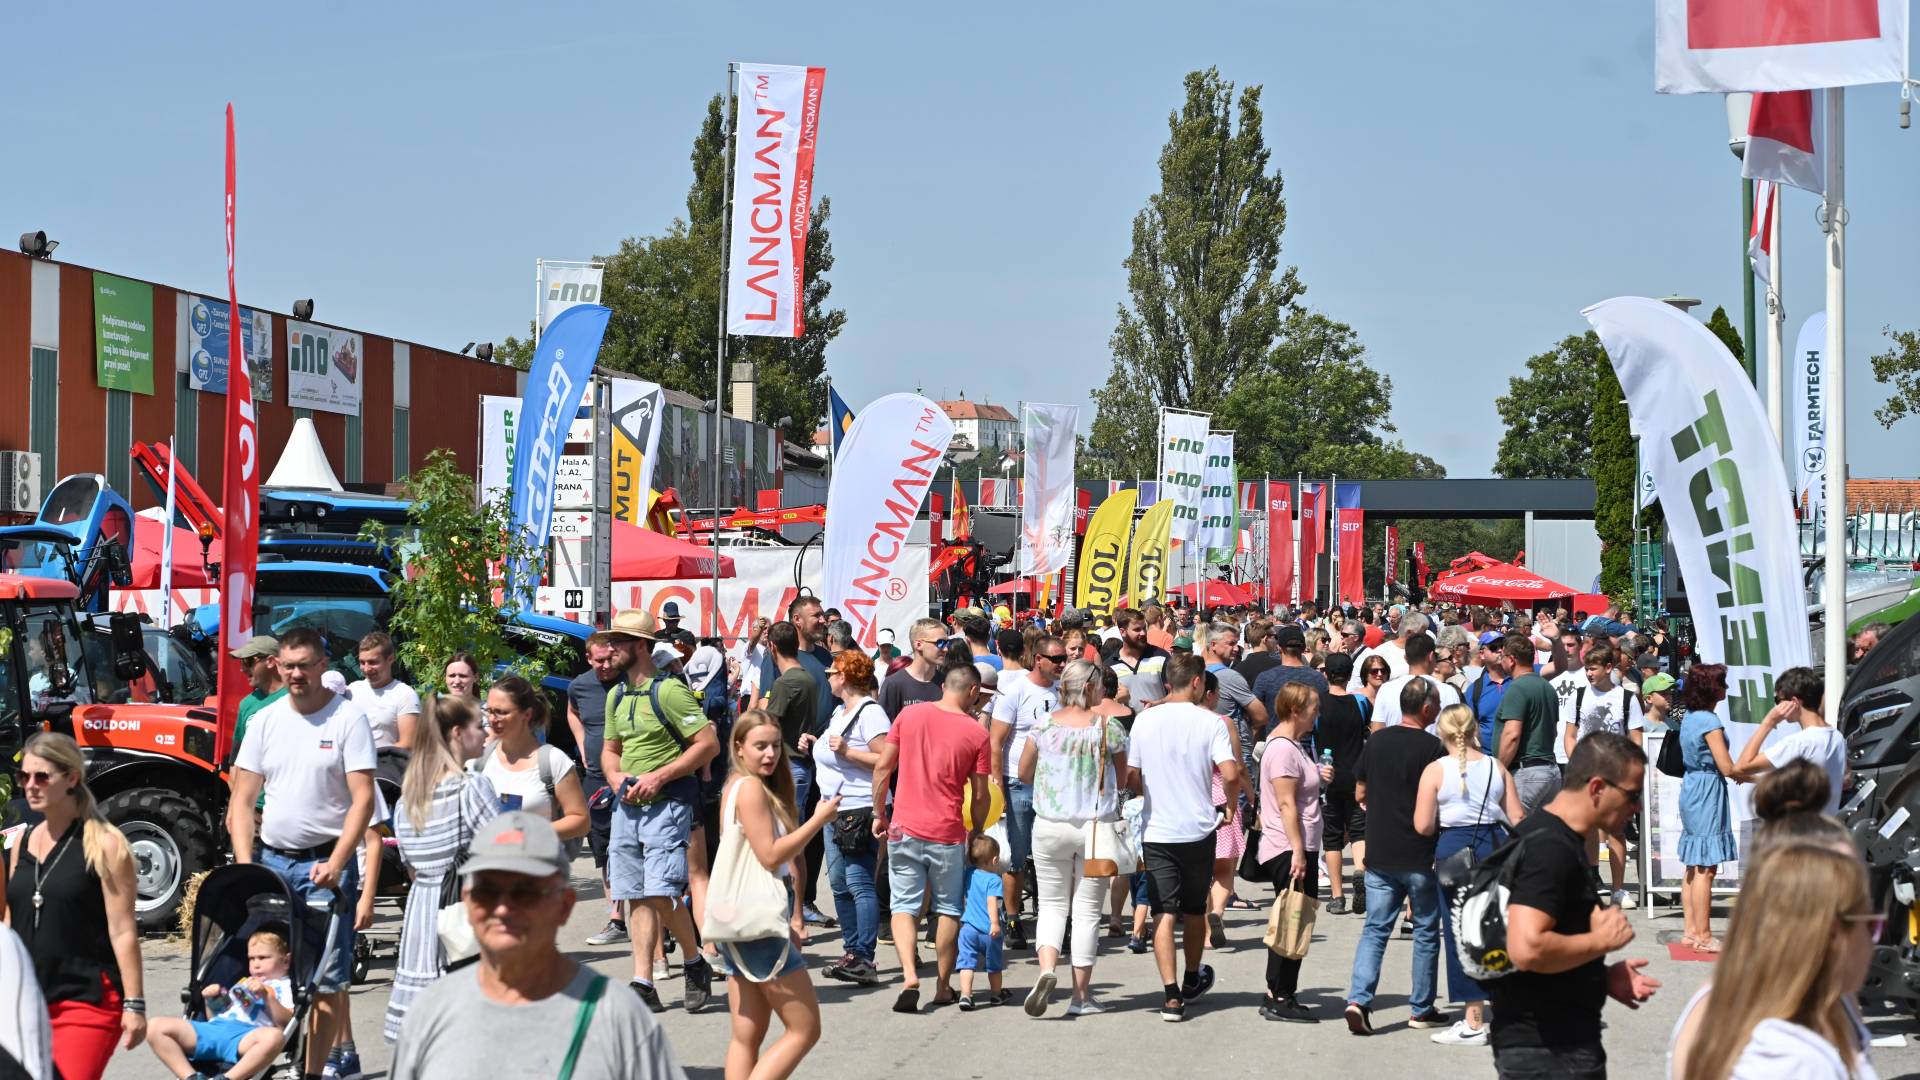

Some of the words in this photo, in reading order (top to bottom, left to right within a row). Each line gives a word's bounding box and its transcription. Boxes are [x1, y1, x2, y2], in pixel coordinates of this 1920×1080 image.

[803, 88, 819, 150] LANCMAN
[745, 108, 786, 321] LANCMAN
[793, 179, 808, 239] LANCMAN
[548, 283, 598, 302] ino
[291, 332, 328, 376] ino
[1806, 350, 1824, 441] FARMTECH
[1168, 436, 1204, 454] ino
[562, 458, 580, 466] Hala
[1167, 468, 1202, 488] ino
[1202, 486, 1232, 497] ino
[1272, 500, 1288, 511] SIP
[1202, 515, 1231, 528] ino
[1342, 523, 1360, 531] SIP
[1440, 583, 1469, 594] Coca-Cola
[1467, 576, 1548, 589] Coca-Cola
[84, 720, 141, 732] GOLDONI
